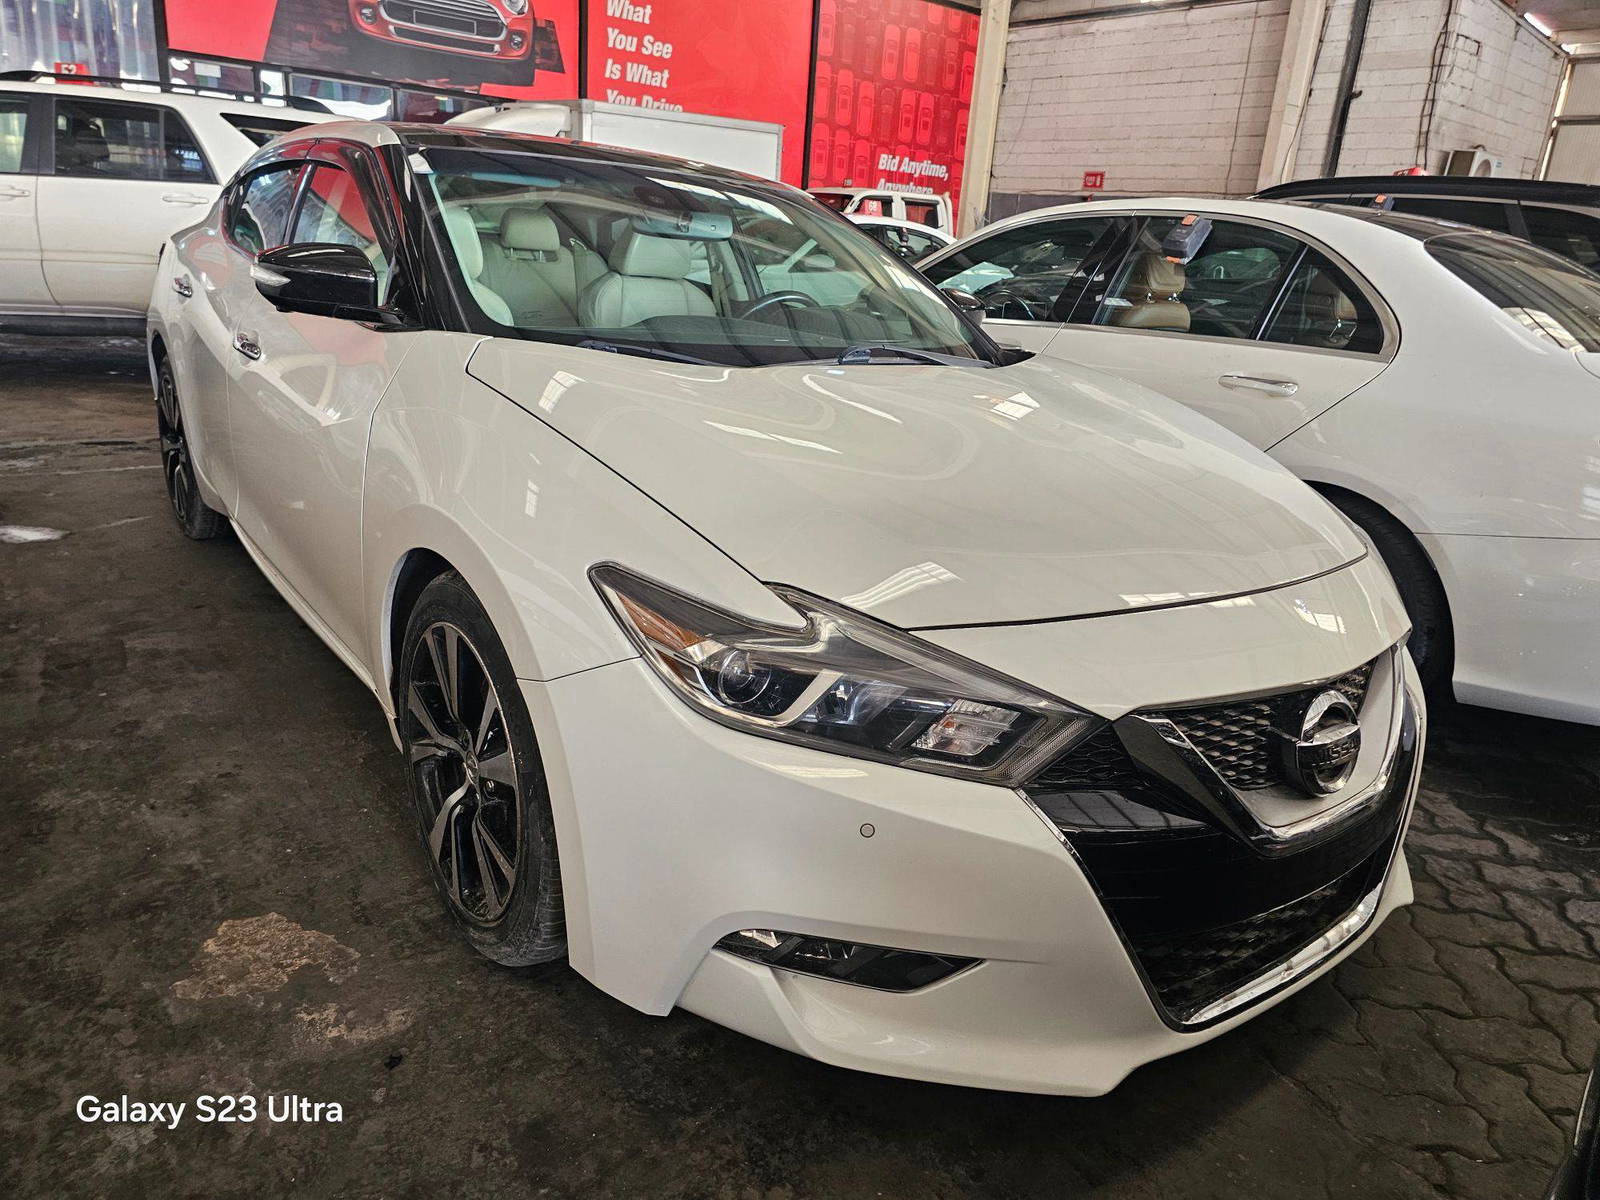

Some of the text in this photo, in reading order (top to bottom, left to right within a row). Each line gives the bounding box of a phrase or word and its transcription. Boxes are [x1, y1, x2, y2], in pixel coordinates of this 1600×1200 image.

[606, 0, 652, 24] What
[606, 27, 673, 59] You See
[604, 58, 670, 89] Is What
[878, 153, 949, 181] Bid Anytime,
